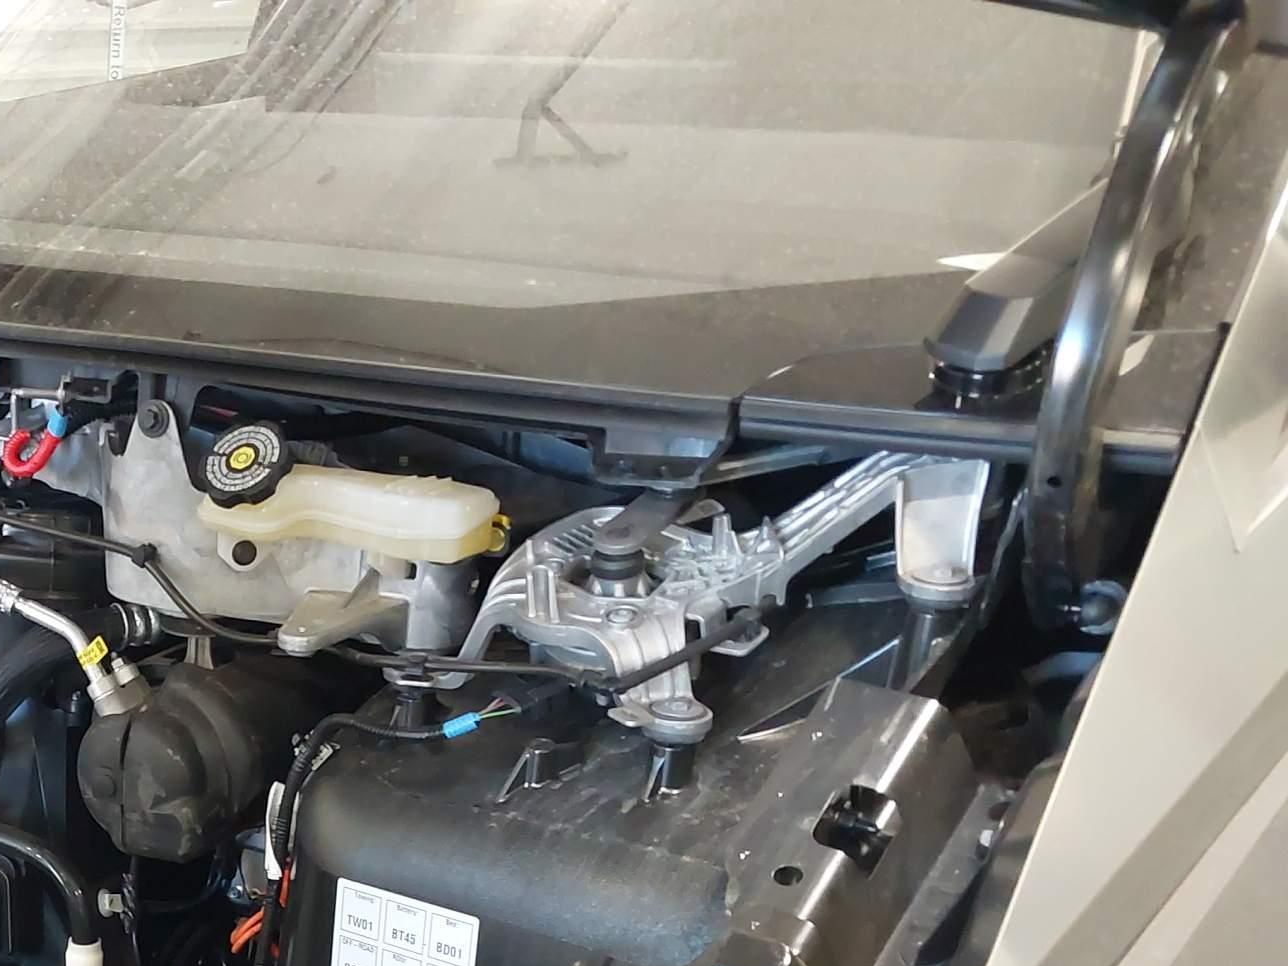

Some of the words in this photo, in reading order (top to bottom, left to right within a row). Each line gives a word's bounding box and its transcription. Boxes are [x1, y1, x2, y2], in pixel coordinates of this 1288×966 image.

[347, 915, 373, 932] TW01
[391, 928, 417, 945] BT45
[436, 942, 462, 959] BD01
